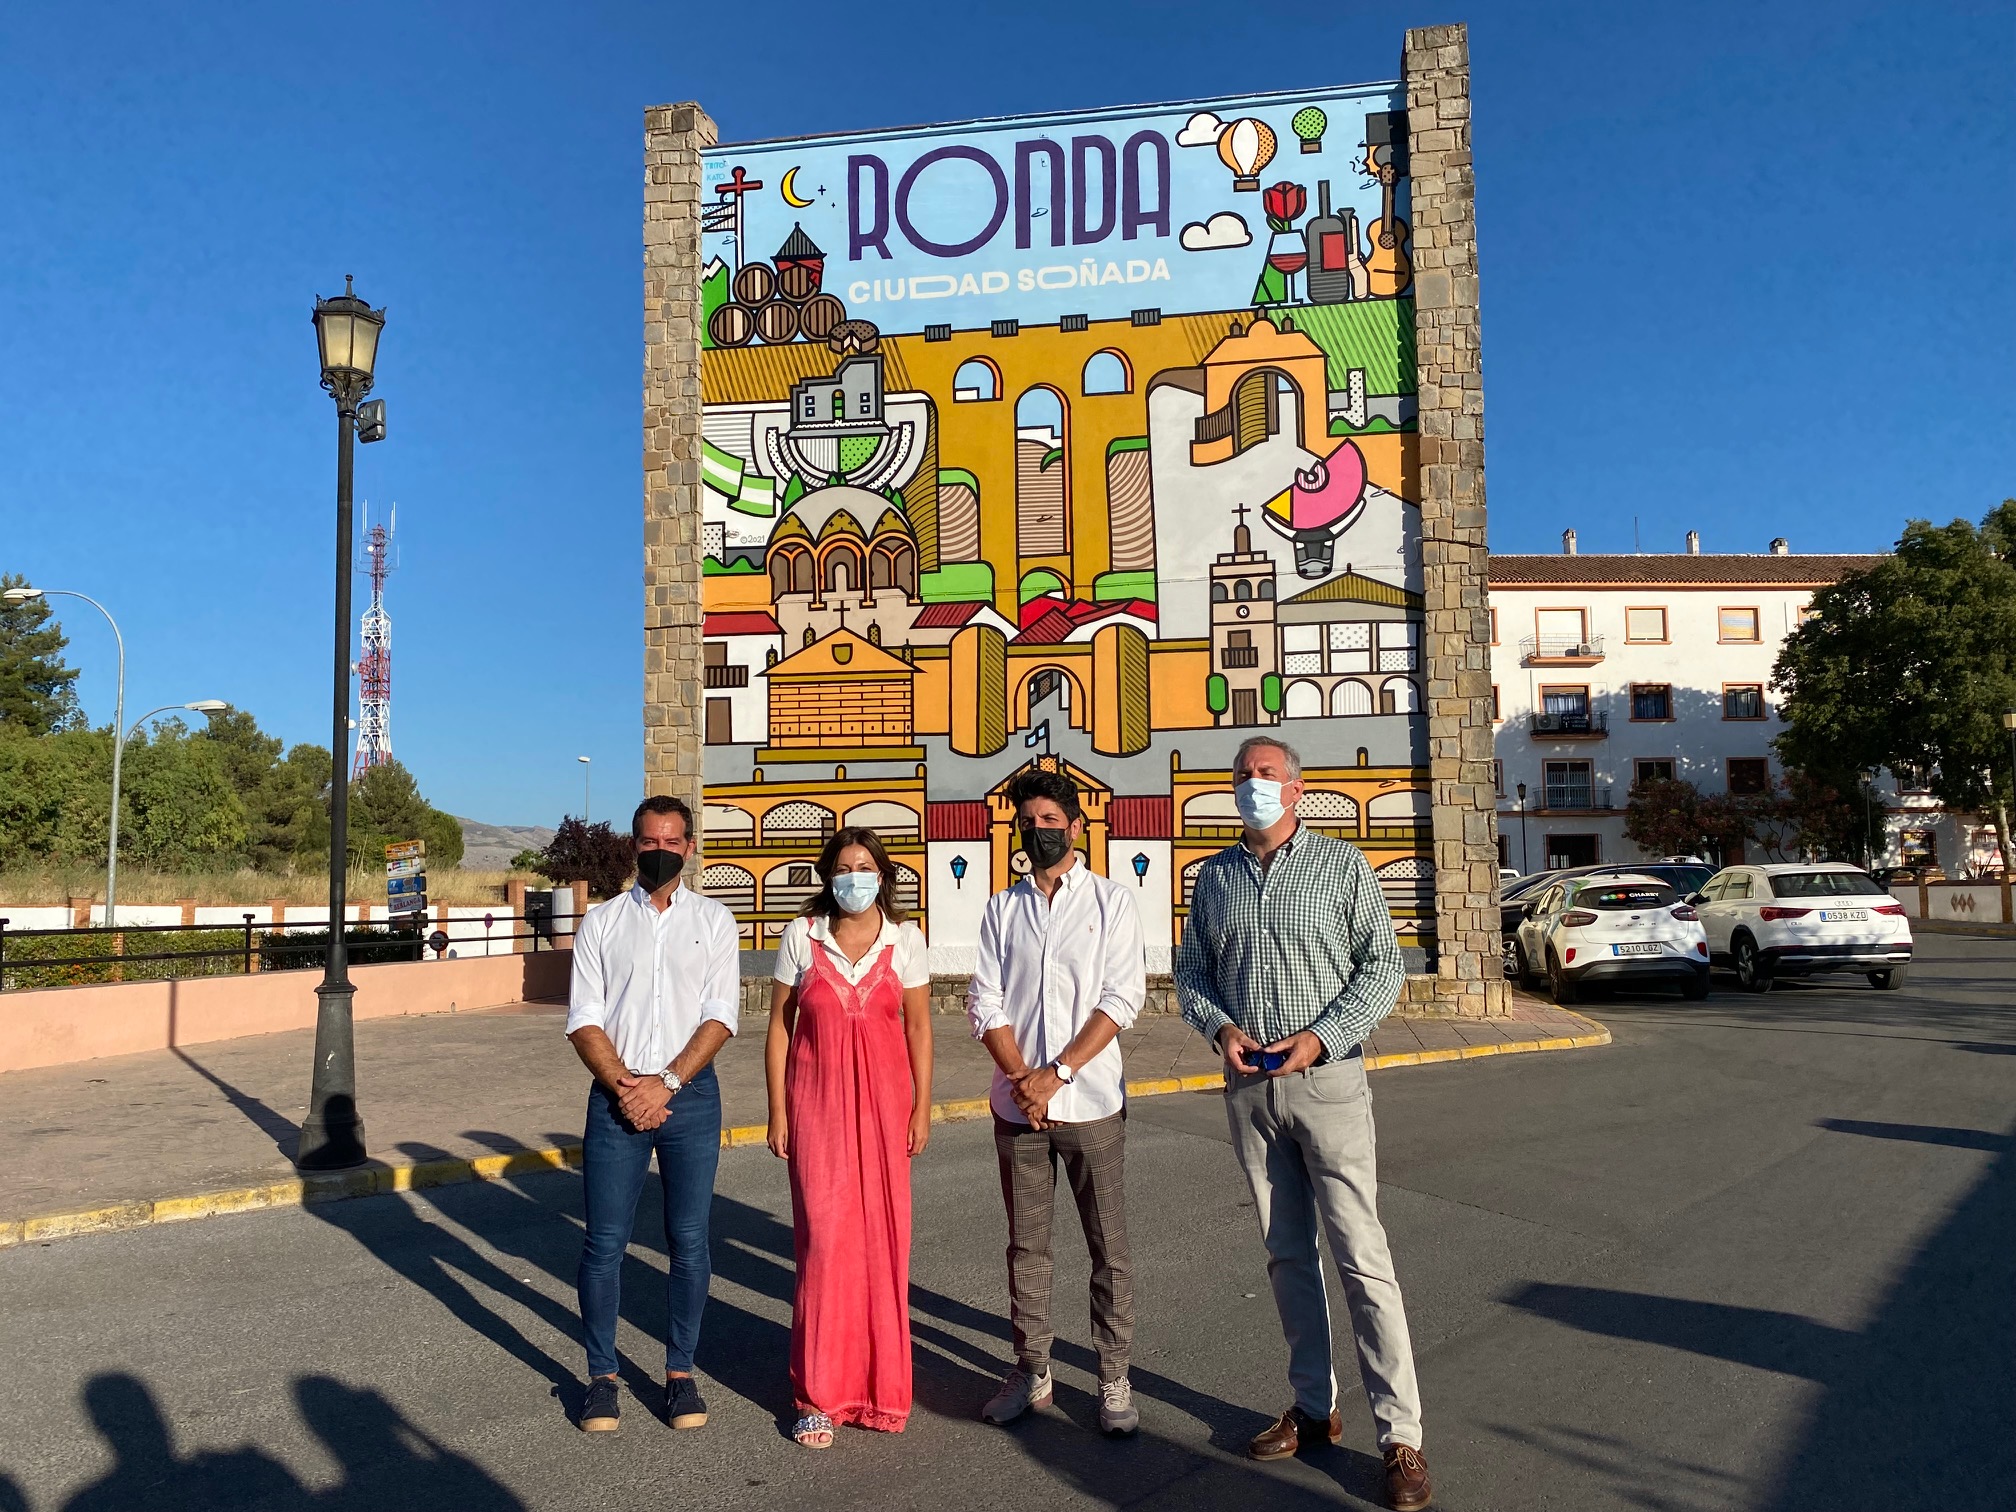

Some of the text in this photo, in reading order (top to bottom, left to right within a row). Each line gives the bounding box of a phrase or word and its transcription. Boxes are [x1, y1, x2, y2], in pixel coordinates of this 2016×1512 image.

[706, 173, 726, 181] KATO
[847, 129, 1171, 261] RONDA
[848, 257, 1171, 304] CIUDAD SOÑADA
[1827, 911, 1867, 920] 0538 KZD
[1619, 945, 1641, 953] 5210
